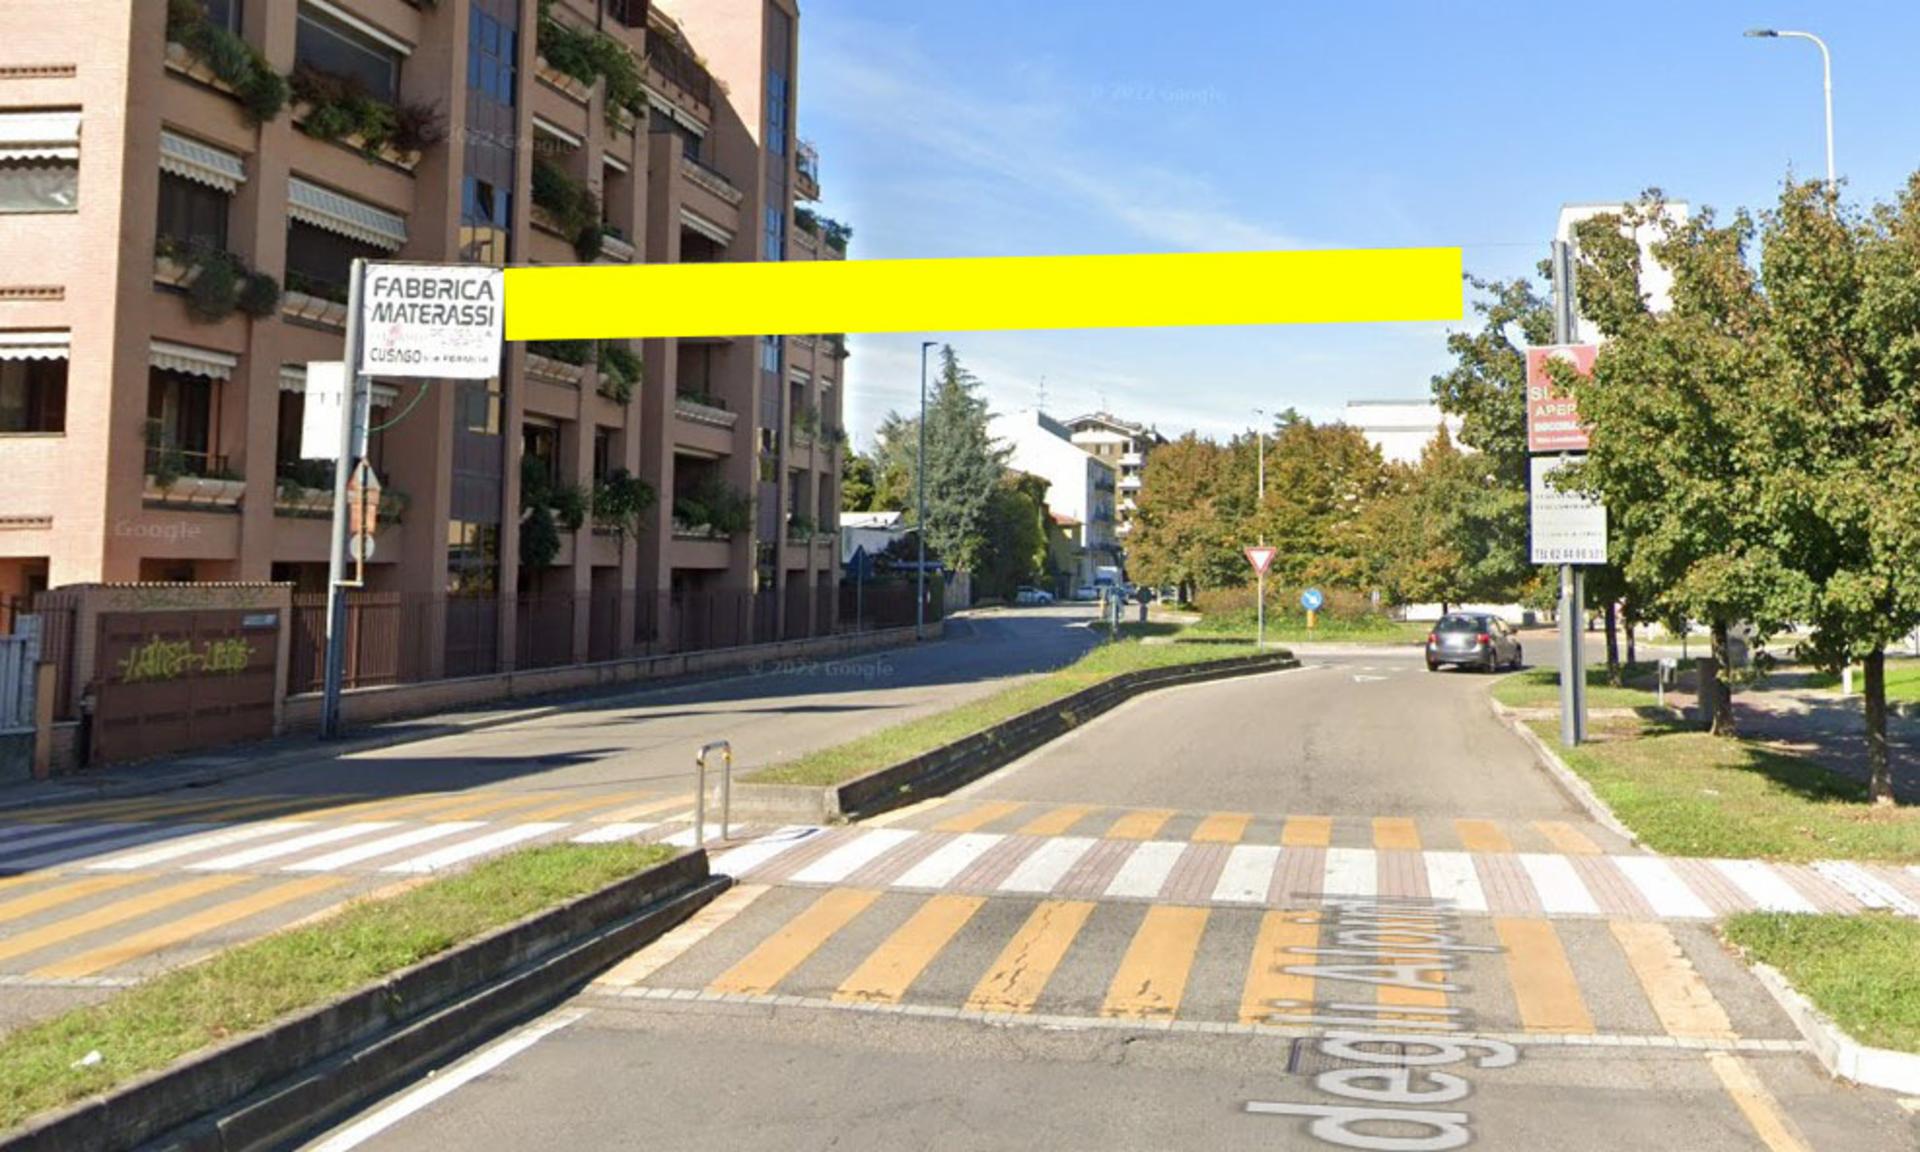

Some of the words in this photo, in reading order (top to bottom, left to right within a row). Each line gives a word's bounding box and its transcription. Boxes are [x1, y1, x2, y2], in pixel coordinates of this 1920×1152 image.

[374, 276, 494, 301] FABBRICA
[371, 302, 494, 327] MATERASSI
[370, 347, 422, 364] CUSAGO
